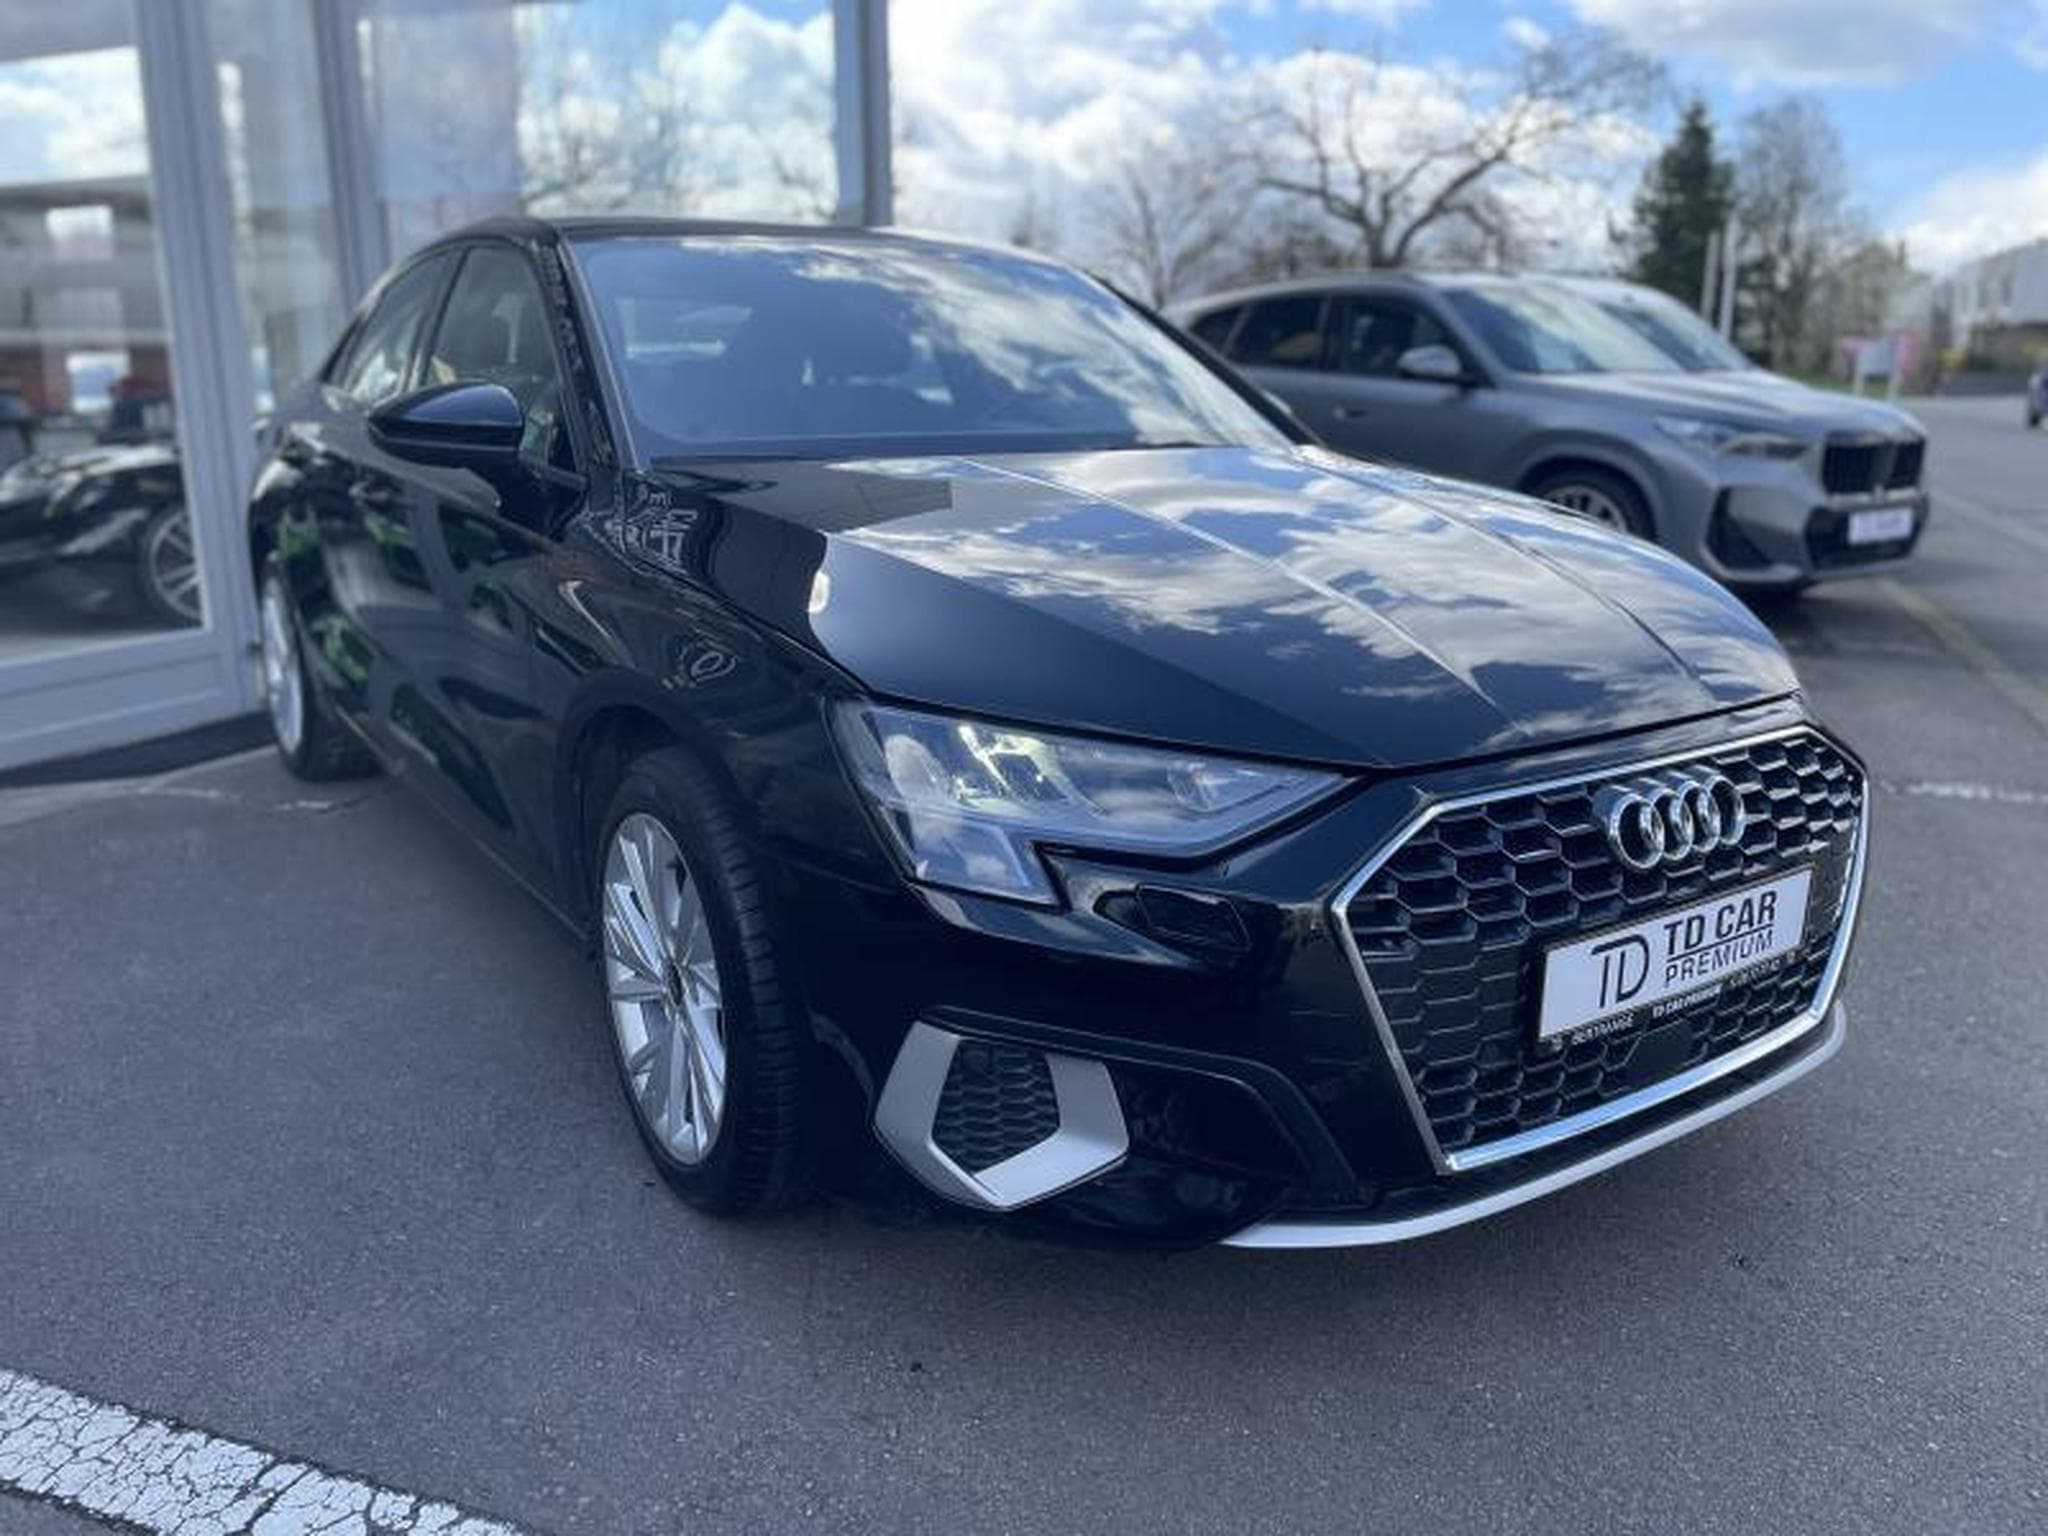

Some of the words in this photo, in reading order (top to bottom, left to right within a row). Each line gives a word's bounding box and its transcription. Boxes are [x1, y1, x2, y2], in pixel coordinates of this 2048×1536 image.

[1664, 914, 1706, 955] TD
[1716, 890, 1777, 940] CAR
[1664, 929, 1773, 987] PREMIUM
